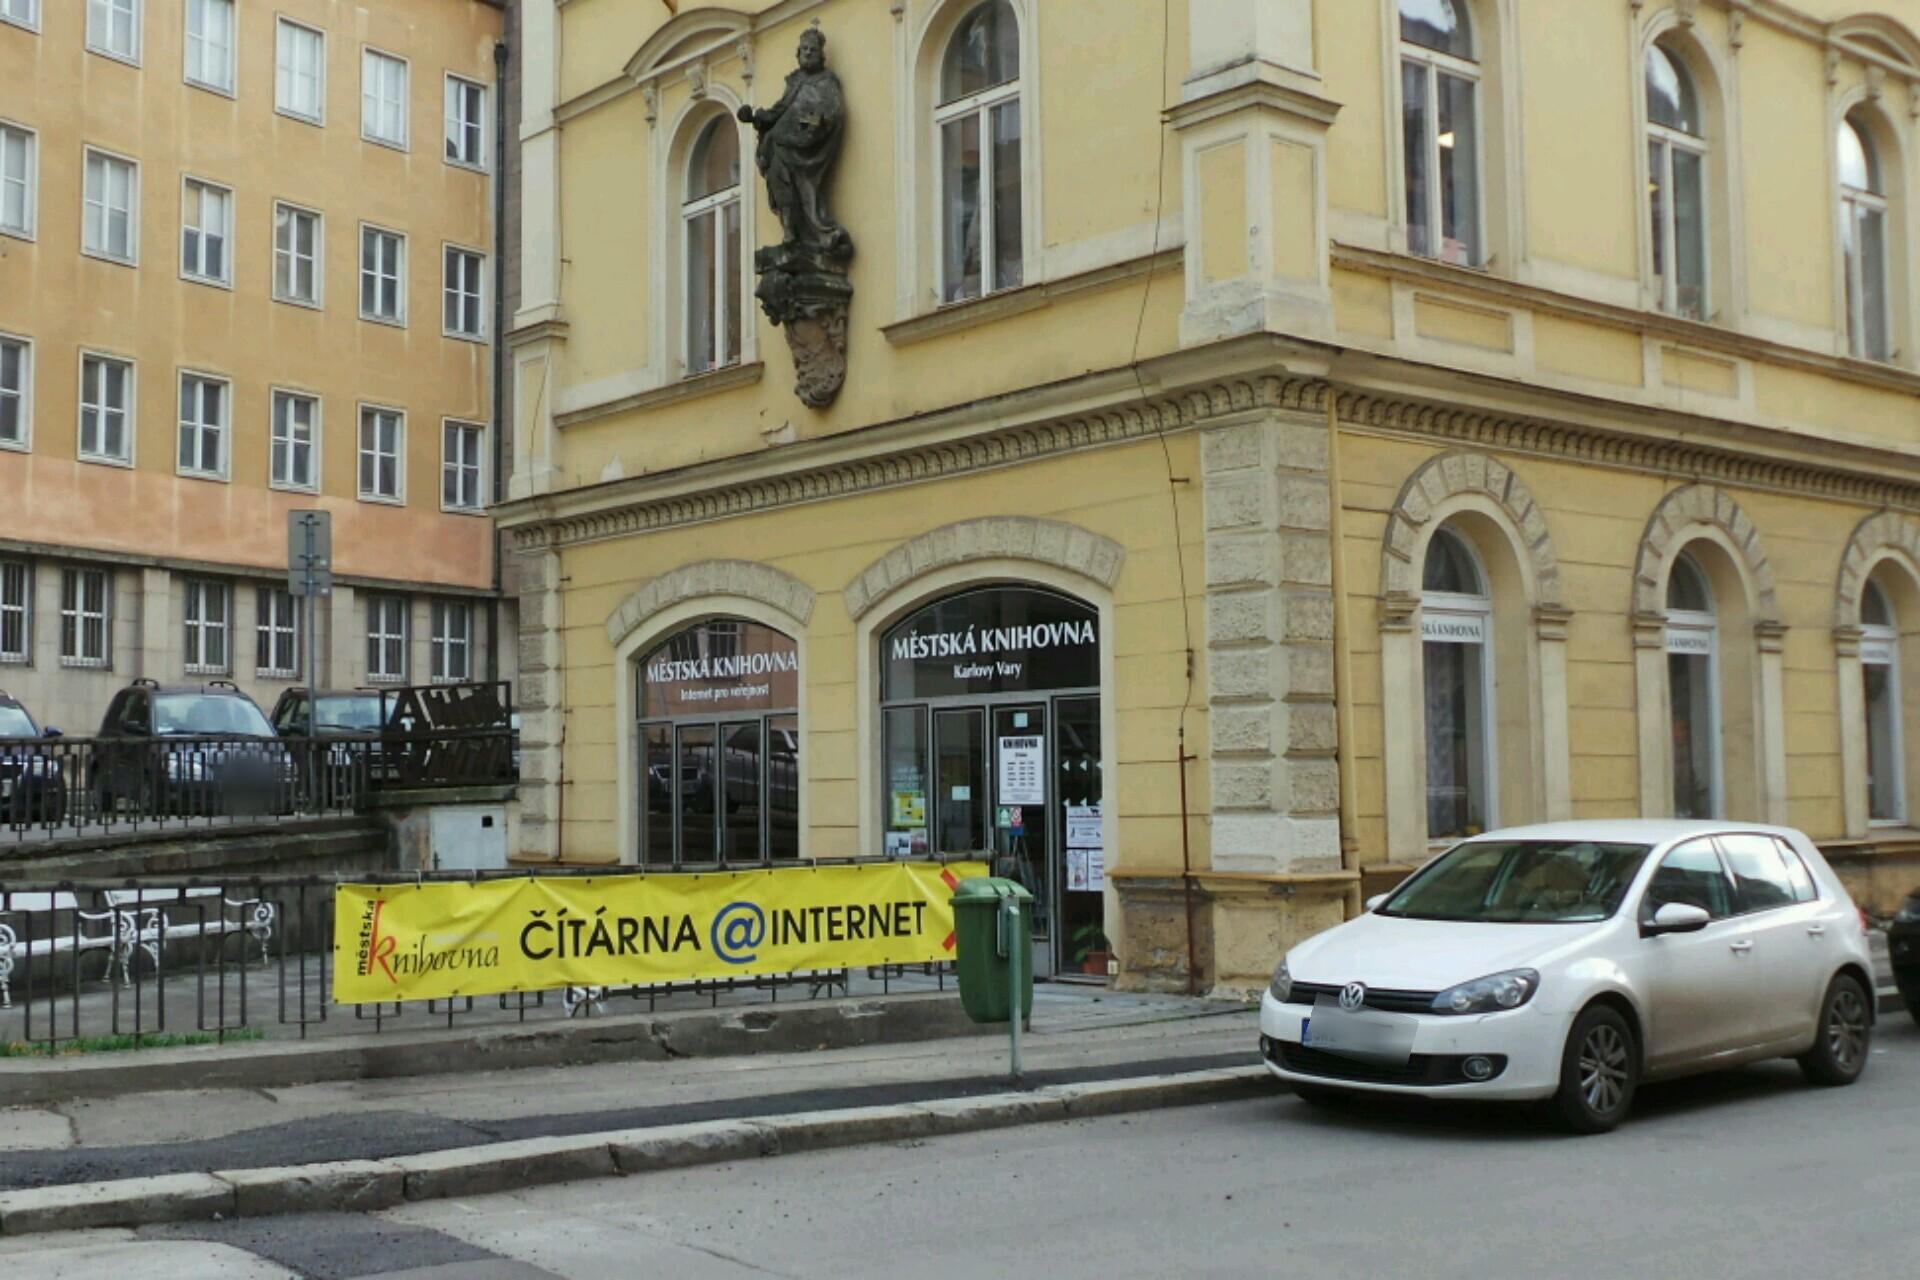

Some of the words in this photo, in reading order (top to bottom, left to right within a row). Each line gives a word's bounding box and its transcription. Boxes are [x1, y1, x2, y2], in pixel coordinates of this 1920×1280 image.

[892, 624, 976, 660] MĚSTSKÁ
[980, 619, 1096, 653] KNIHOVNA
[647, 653, 710, 683] MĚSTSKÁ
[713, 650, 799, 677] KNIHOVNA
[953, 663, 994, 680] Karlovy
[996, 661, 1022, 679] Vary
[680, 687, 713, 701] Internet
[714, 687, 729, 702] pro
[357, 900, 375, 976] městská
[520, 906, 702, 960] ČÍTÁRNA
